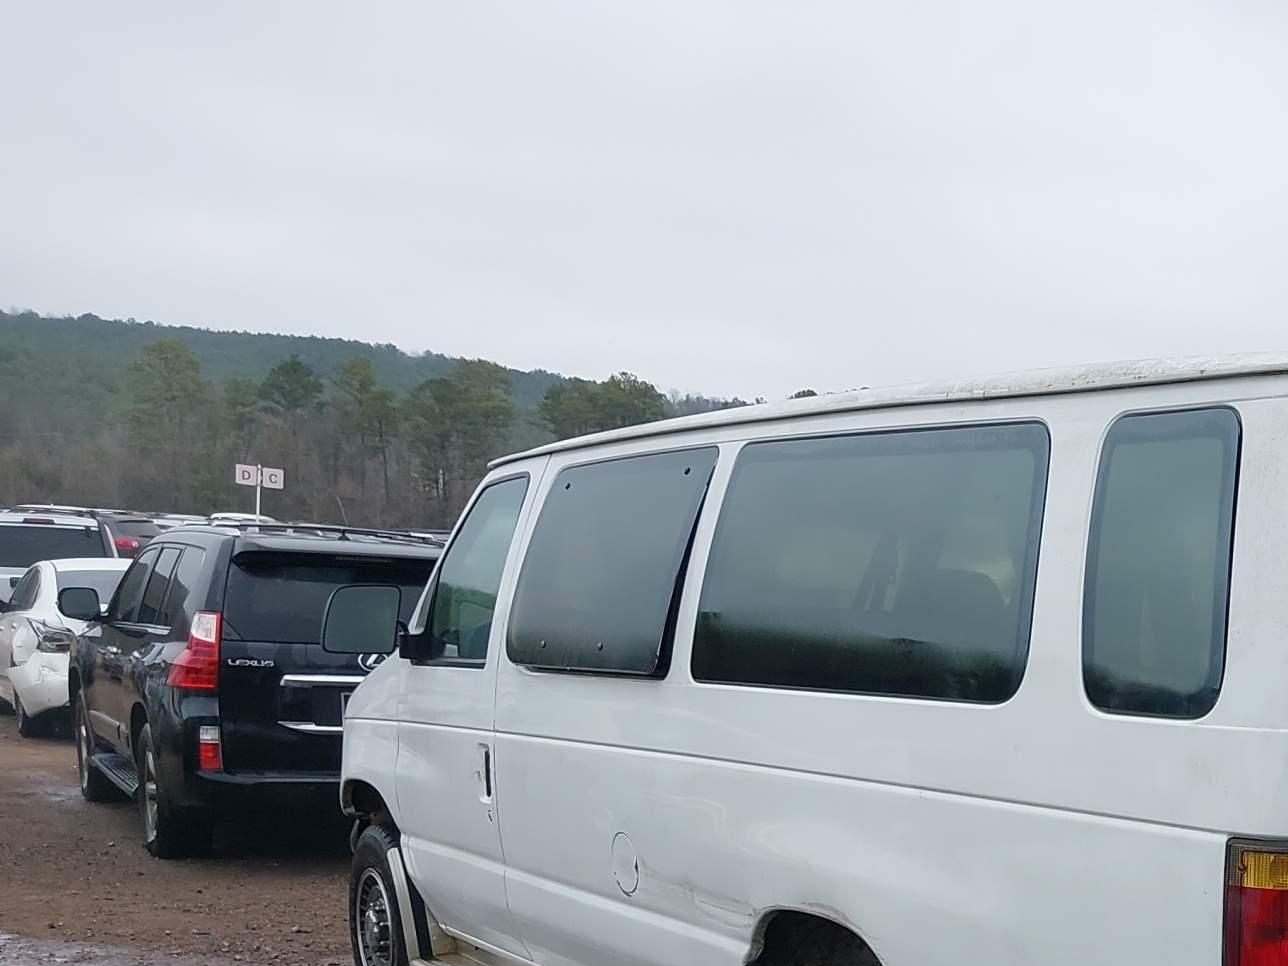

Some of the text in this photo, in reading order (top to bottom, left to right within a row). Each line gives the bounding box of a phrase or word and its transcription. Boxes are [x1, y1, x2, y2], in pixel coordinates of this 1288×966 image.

[242, 470, 251, 480] D
[269, 474, 278, 483] C
[228, 658, 274, 667] LEXUS
